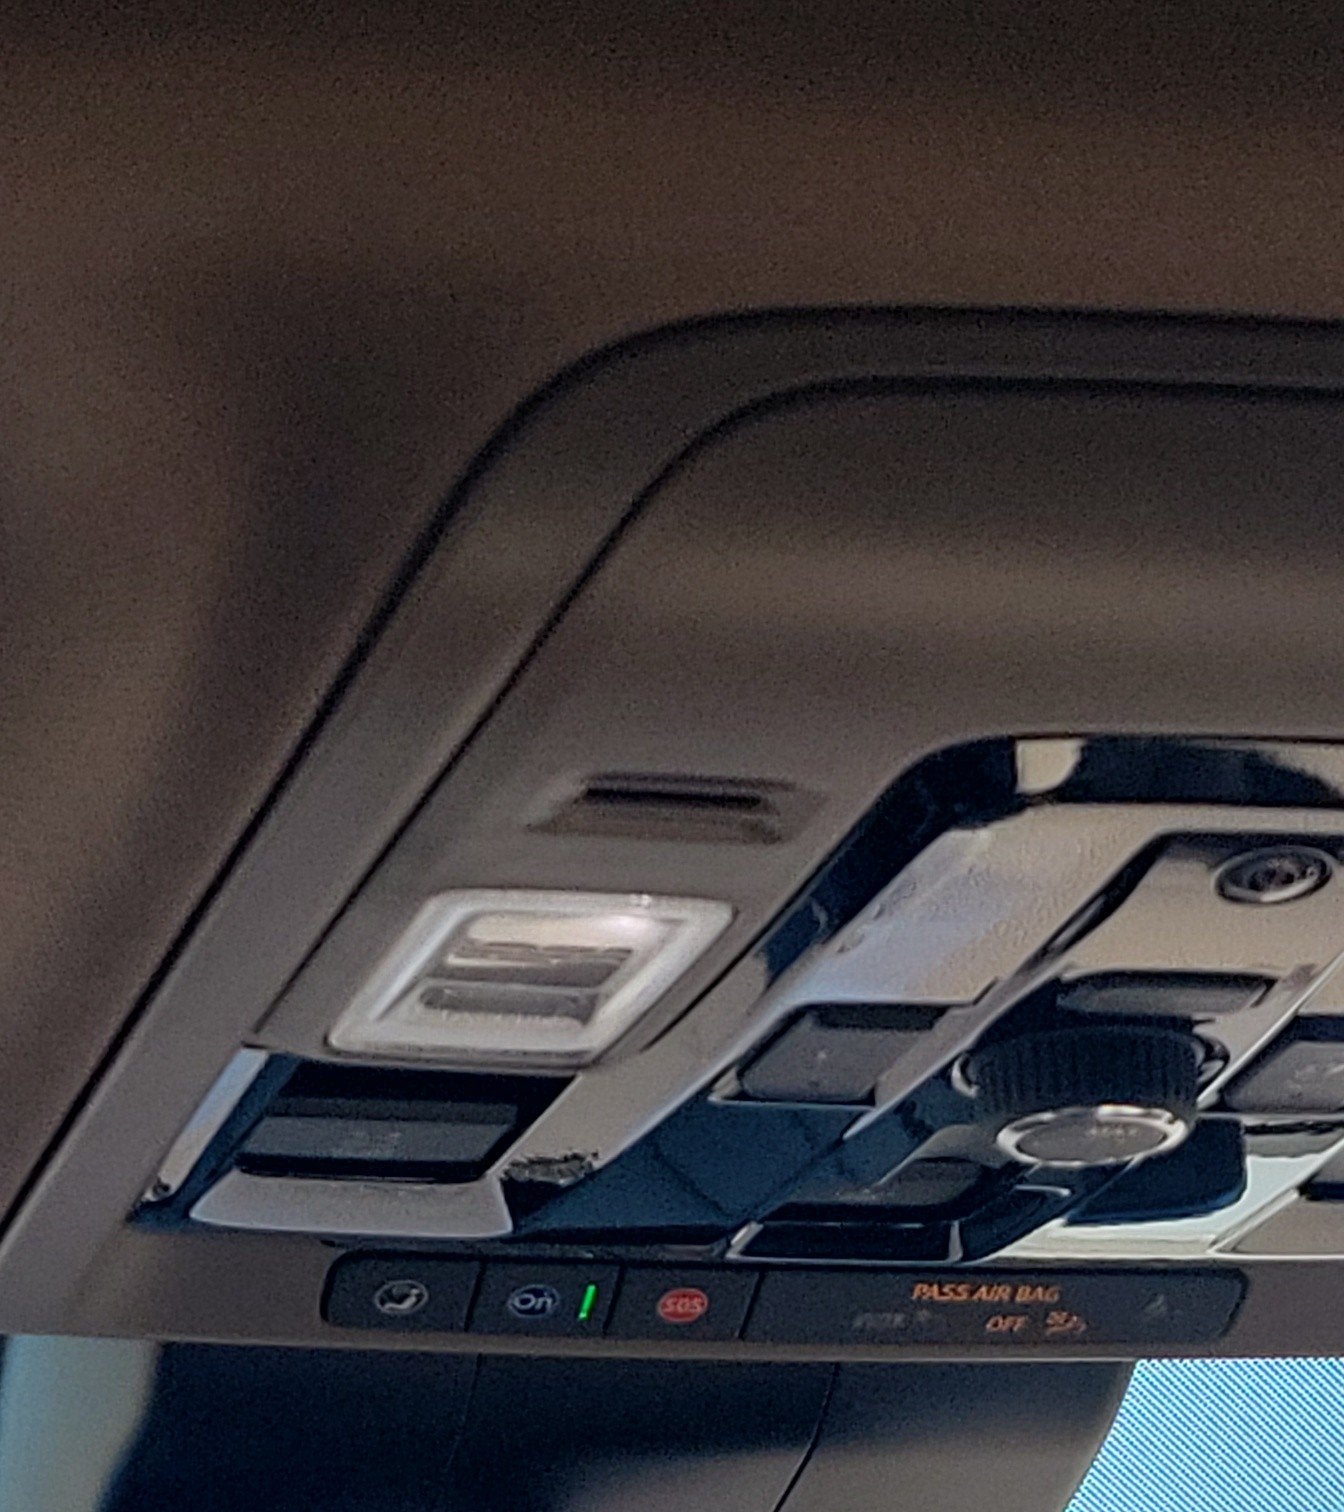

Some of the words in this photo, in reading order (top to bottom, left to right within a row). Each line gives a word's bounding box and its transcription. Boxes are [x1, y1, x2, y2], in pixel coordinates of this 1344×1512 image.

[912, 1283, 970, 1300] PASS
[971, 1284, 1011, 1300] AIR
[1015, 1284, 1061, 1301] BAG
[662, 1297, 704, 1313] SOS
[986, 1315, 1028, 1332] OFF
